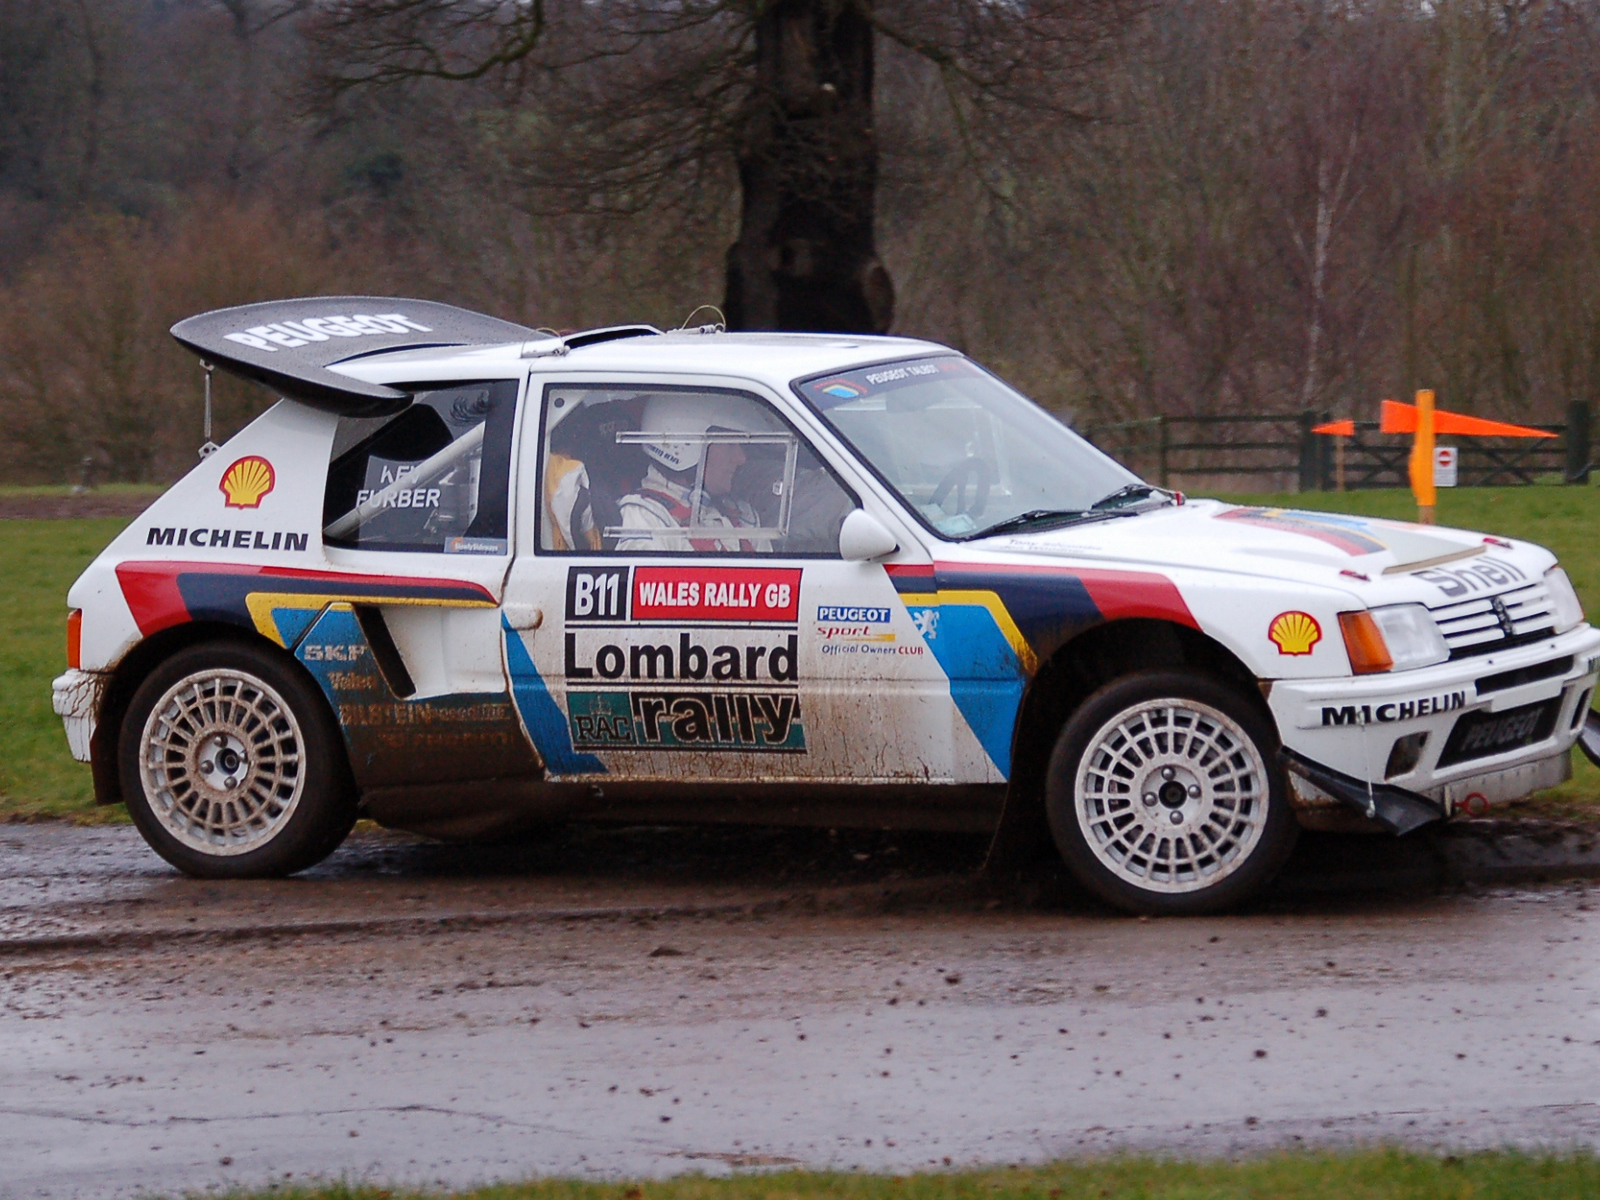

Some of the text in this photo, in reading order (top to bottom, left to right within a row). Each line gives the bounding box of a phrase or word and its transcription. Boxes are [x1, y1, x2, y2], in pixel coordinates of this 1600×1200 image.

[223, 313, 433, 352] PEUGEOT
[866, 368, 909, 385] PEUGEOT
[356, 488, 441, 508] FURBER
[146, 527, 309, 551] MICHELIN
[1410, 556, 1527, 598] Shell
[575, 573, 620, 616] B11
[639, 582, 791, 608] WALES RALLY GB
[819, 607, 888, 622] PEUGEOT
[816, 625, 870, 639] sport
[304, 644, 367, 661] SKF
[564, 632, 798, 681] Lombard
[822, 644, 924, 655] Official Owners CLUB
[638, 693, 799, 745] rally
[1321, 691, 1467, 727] MICHELIN
[574, 714, 633, 741] RAC
